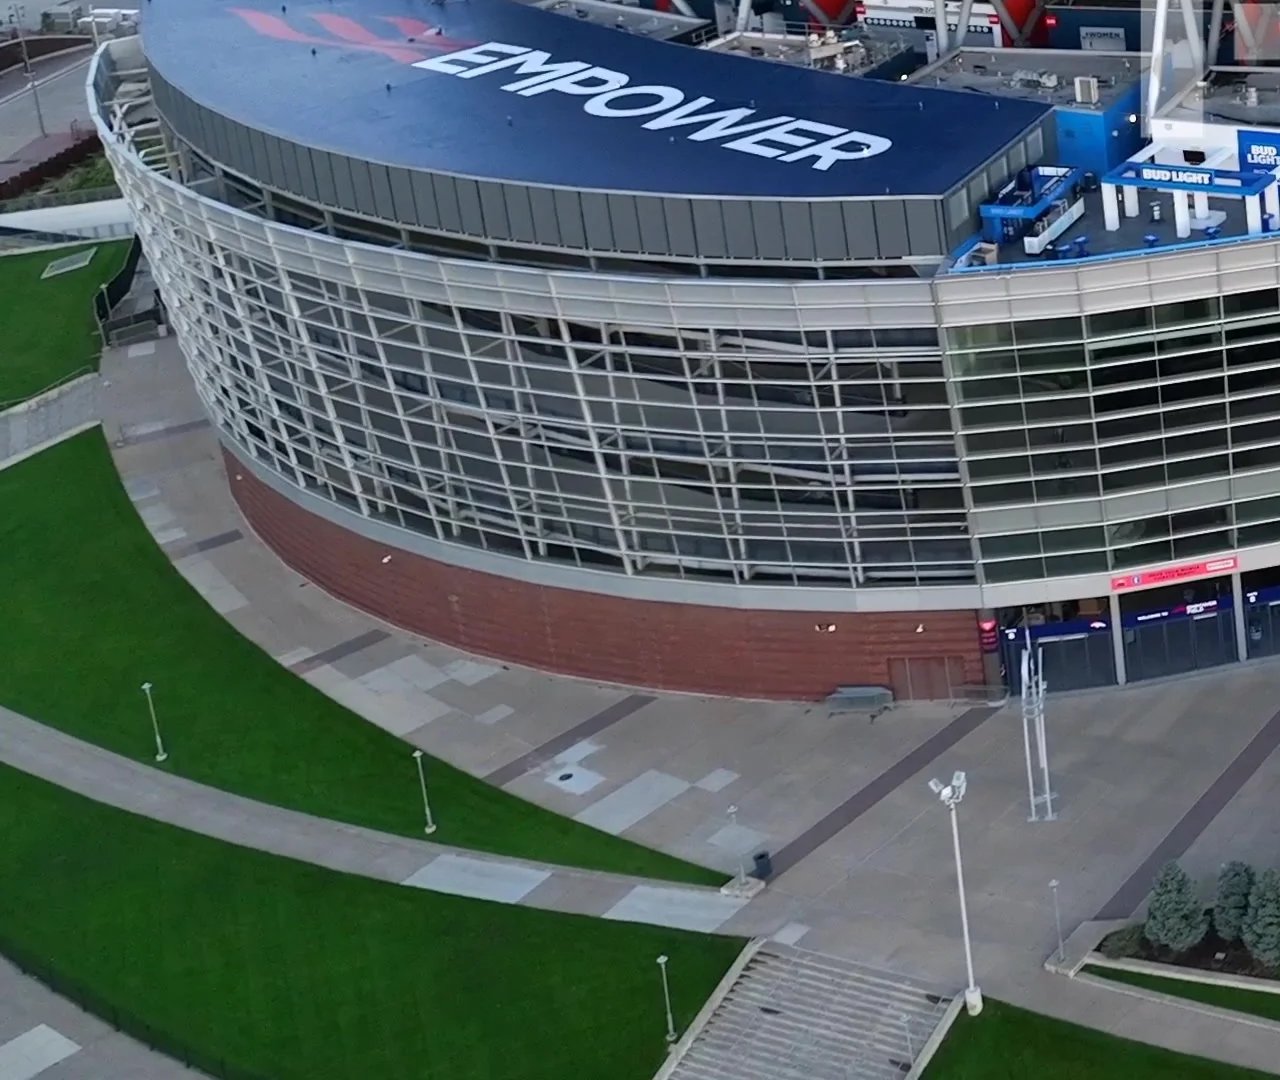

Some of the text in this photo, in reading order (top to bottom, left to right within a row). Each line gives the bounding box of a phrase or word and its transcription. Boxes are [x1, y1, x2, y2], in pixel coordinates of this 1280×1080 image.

[411, 40, 893, 171] EMPOWER
[1251, 144, 1276, 156] BUD
[1142, 169, 1211, 185] BUD LIGHT
[1186, 600, 1217, 611] EMPOWER
[1187, 606, 1205, 615] FIELD
